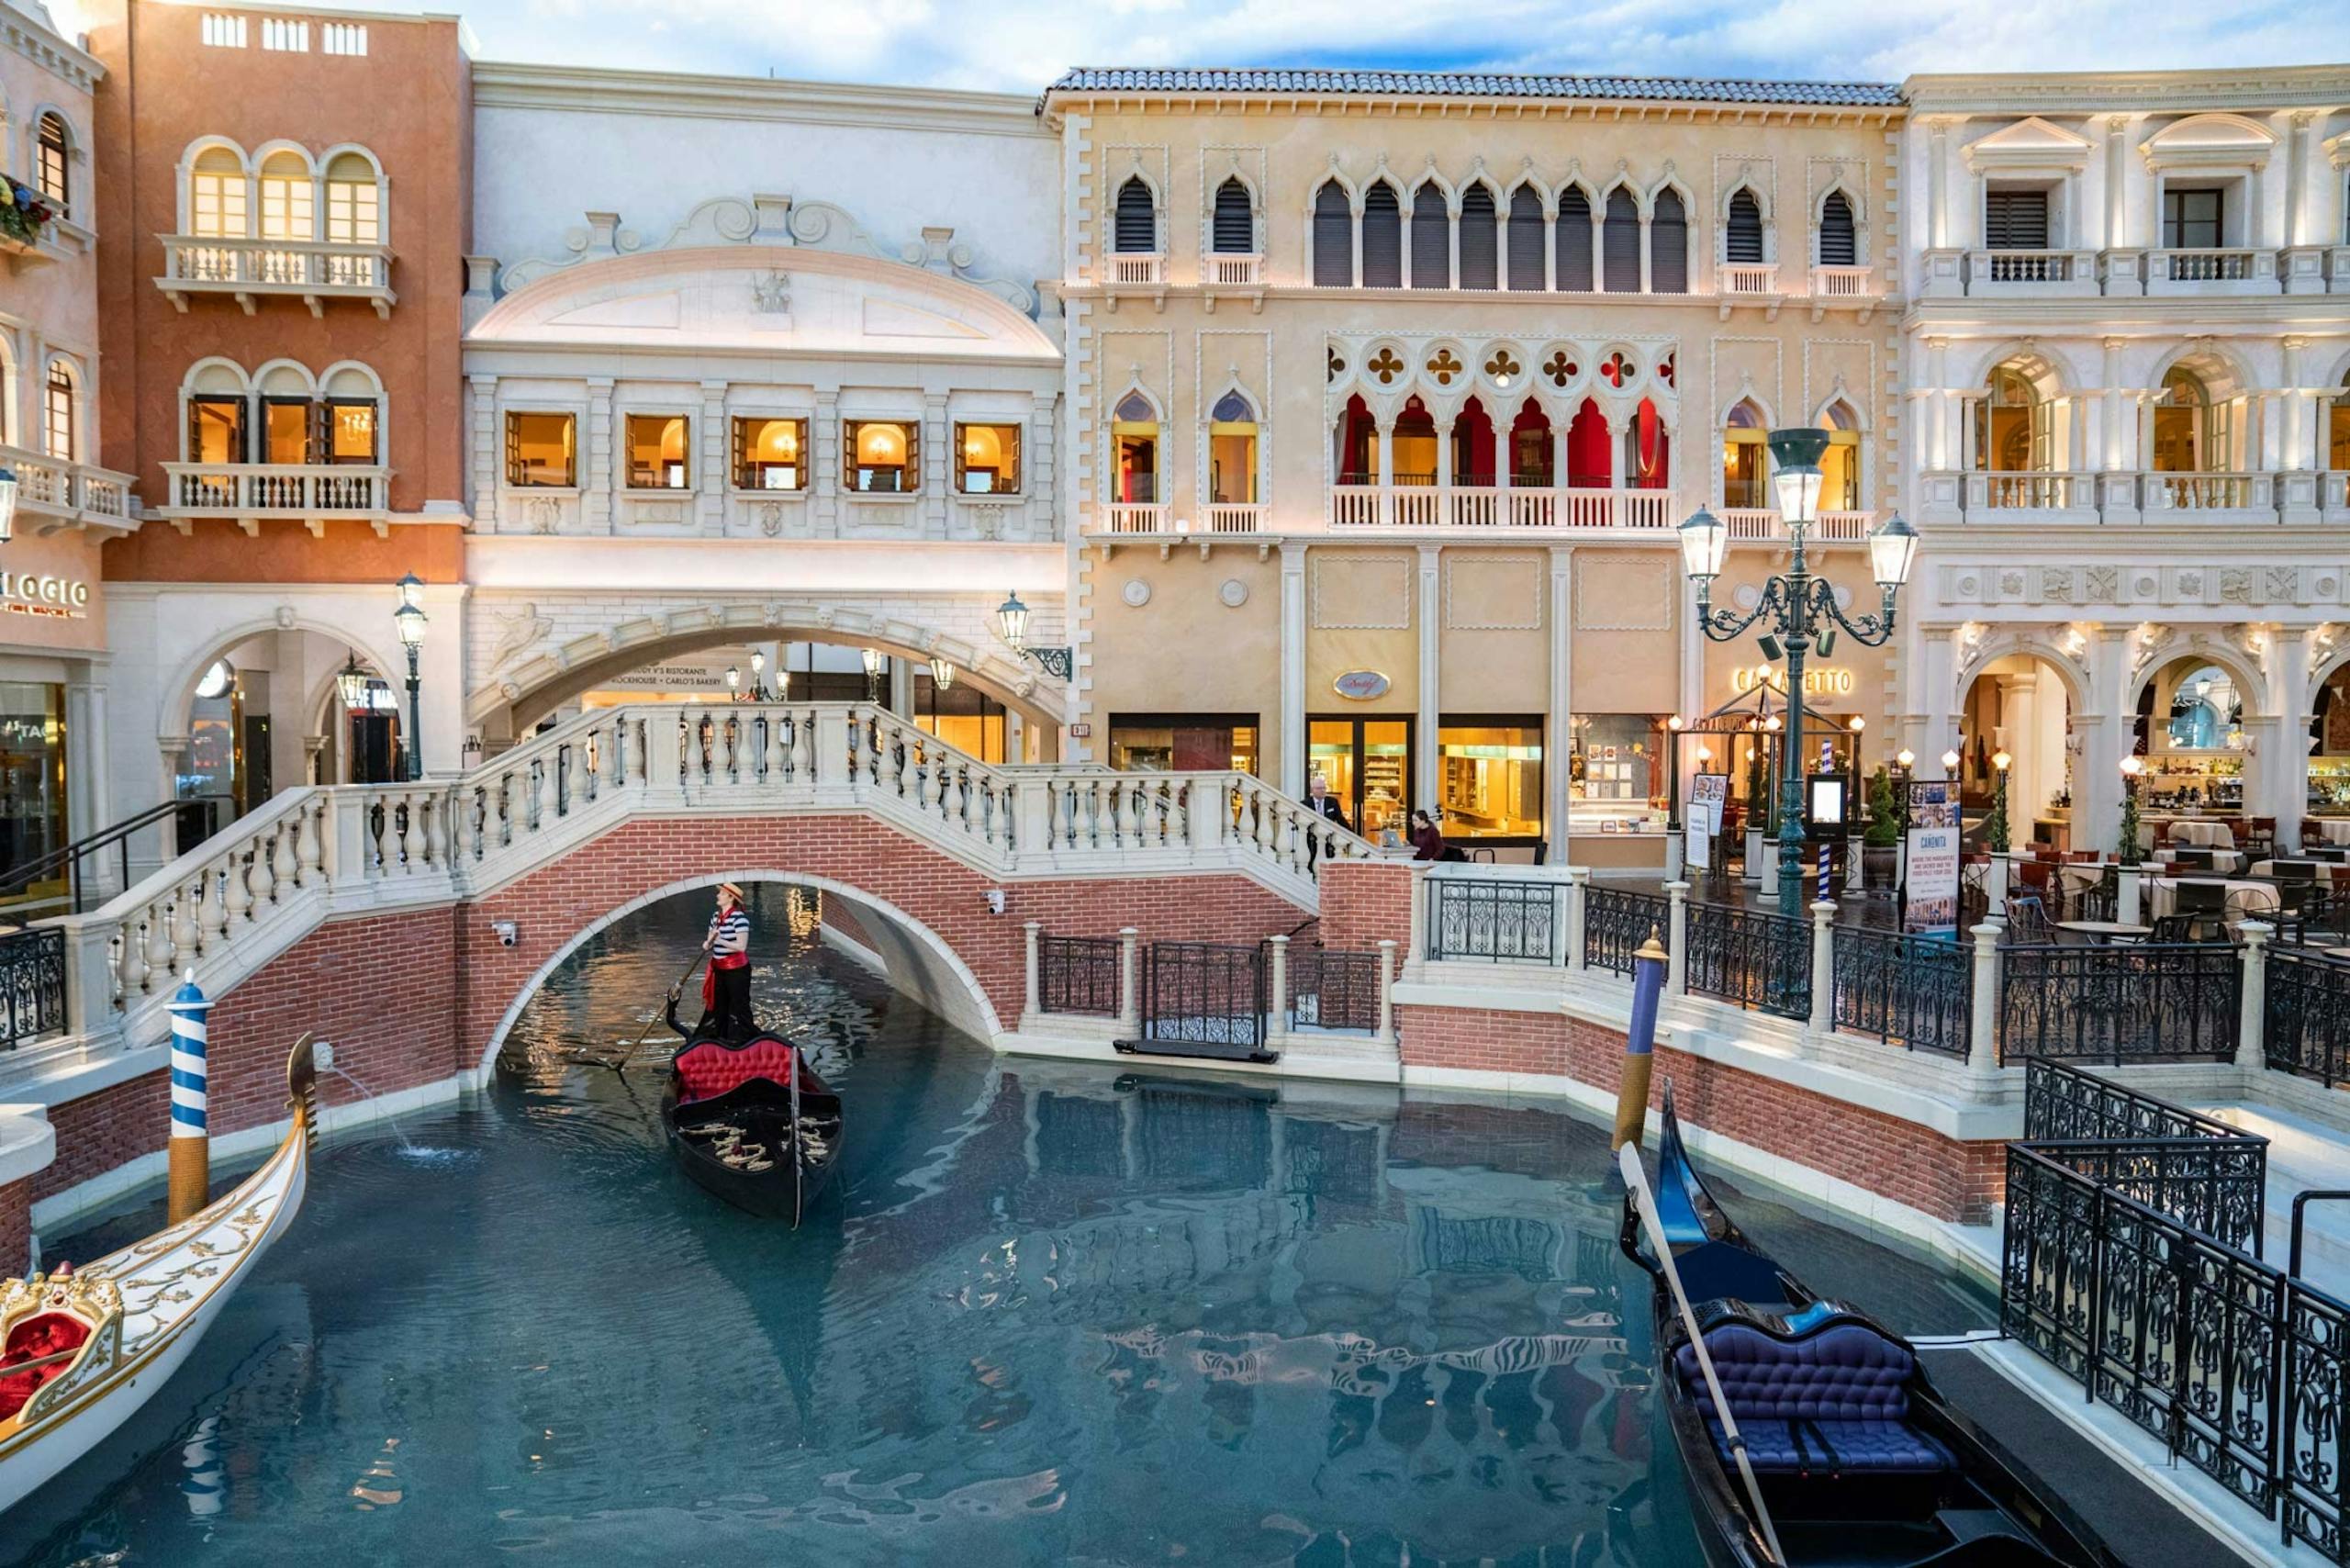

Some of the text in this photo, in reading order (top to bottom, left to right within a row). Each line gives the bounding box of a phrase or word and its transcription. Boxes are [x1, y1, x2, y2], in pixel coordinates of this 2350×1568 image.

[666, 667, 707, 676] RISTORANTE
[666, 678, 695, 686] CARLO'S
[697, 678, 722, 687] BAKERY
[1737, 670, 1852, 691] CAAETTO
[1073, 725, 1088, 735] EXIT
